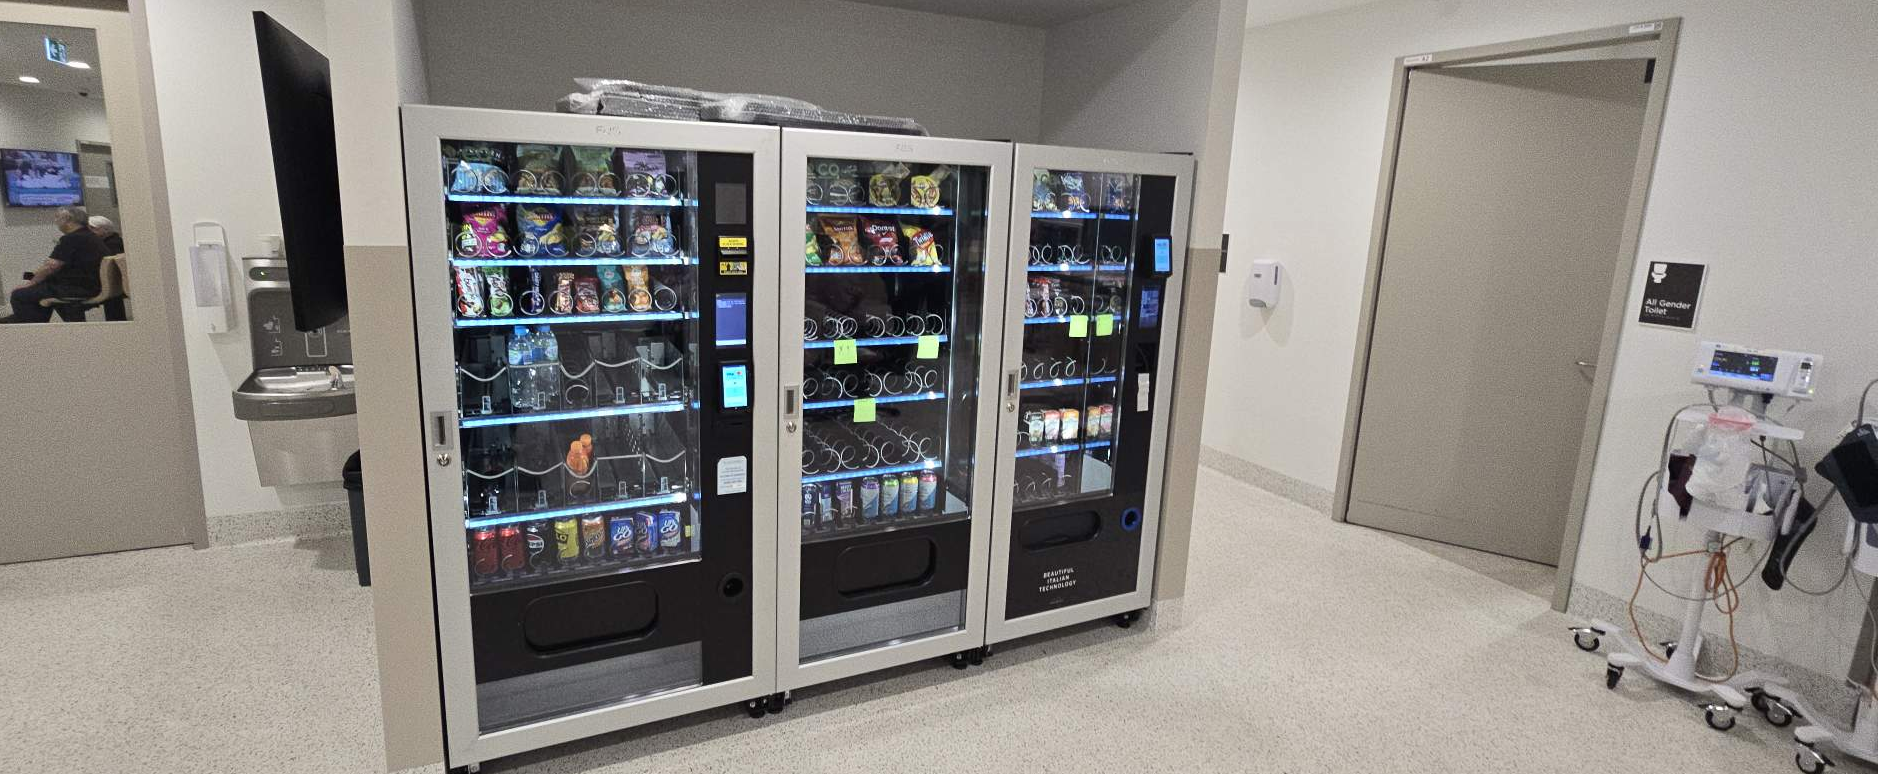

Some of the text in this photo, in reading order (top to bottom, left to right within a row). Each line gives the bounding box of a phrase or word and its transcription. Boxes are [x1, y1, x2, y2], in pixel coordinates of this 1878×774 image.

[1659, 299, 1691, 310] Gender
[1645, 306, 1668, 315] Toilet
[1043, 568, 1074, 578] BEAUTIFUL
[1047, 575, 1070, 583] ITALIAN
[1039, 580, 1076, 592] TECHNOLOGY
